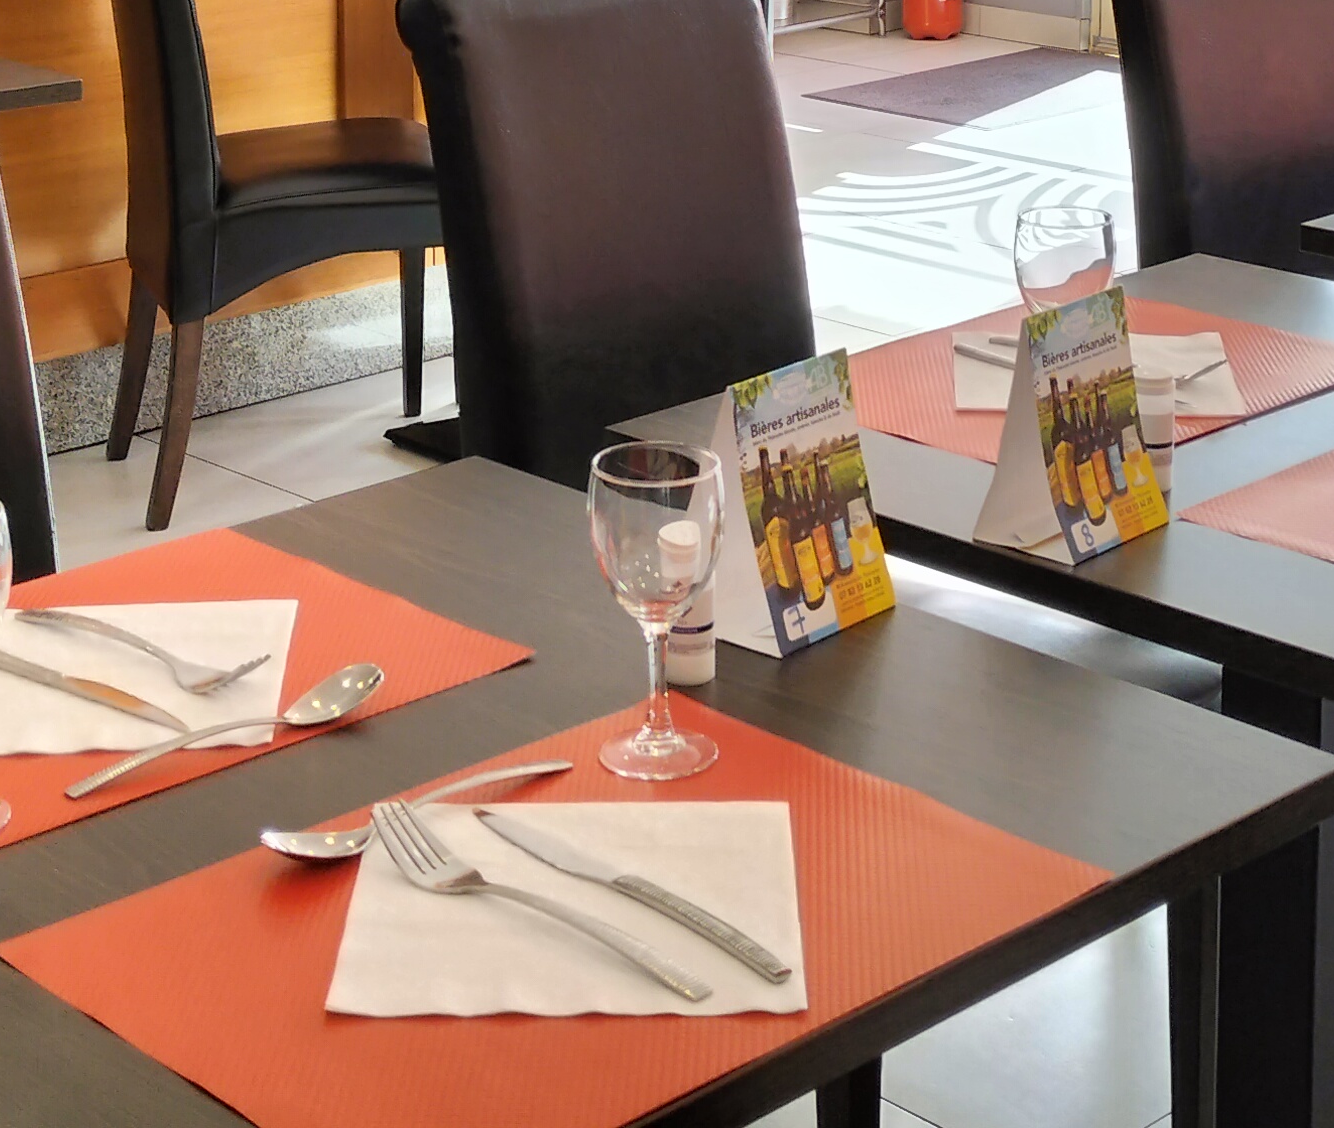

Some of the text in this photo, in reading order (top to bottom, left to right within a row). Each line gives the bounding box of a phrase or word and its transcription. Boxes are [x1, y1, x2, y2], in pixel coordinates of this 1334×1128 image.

[1042, 350, 1069, 368] Bières
[1071, 332, 1117, 357] artisanales
[750, 417, 784, 438] Bières
[786, 397, 840, 426] artisanales
[1081, 524, 1094, 547] 8
[788, 605, 805, 634] 7
